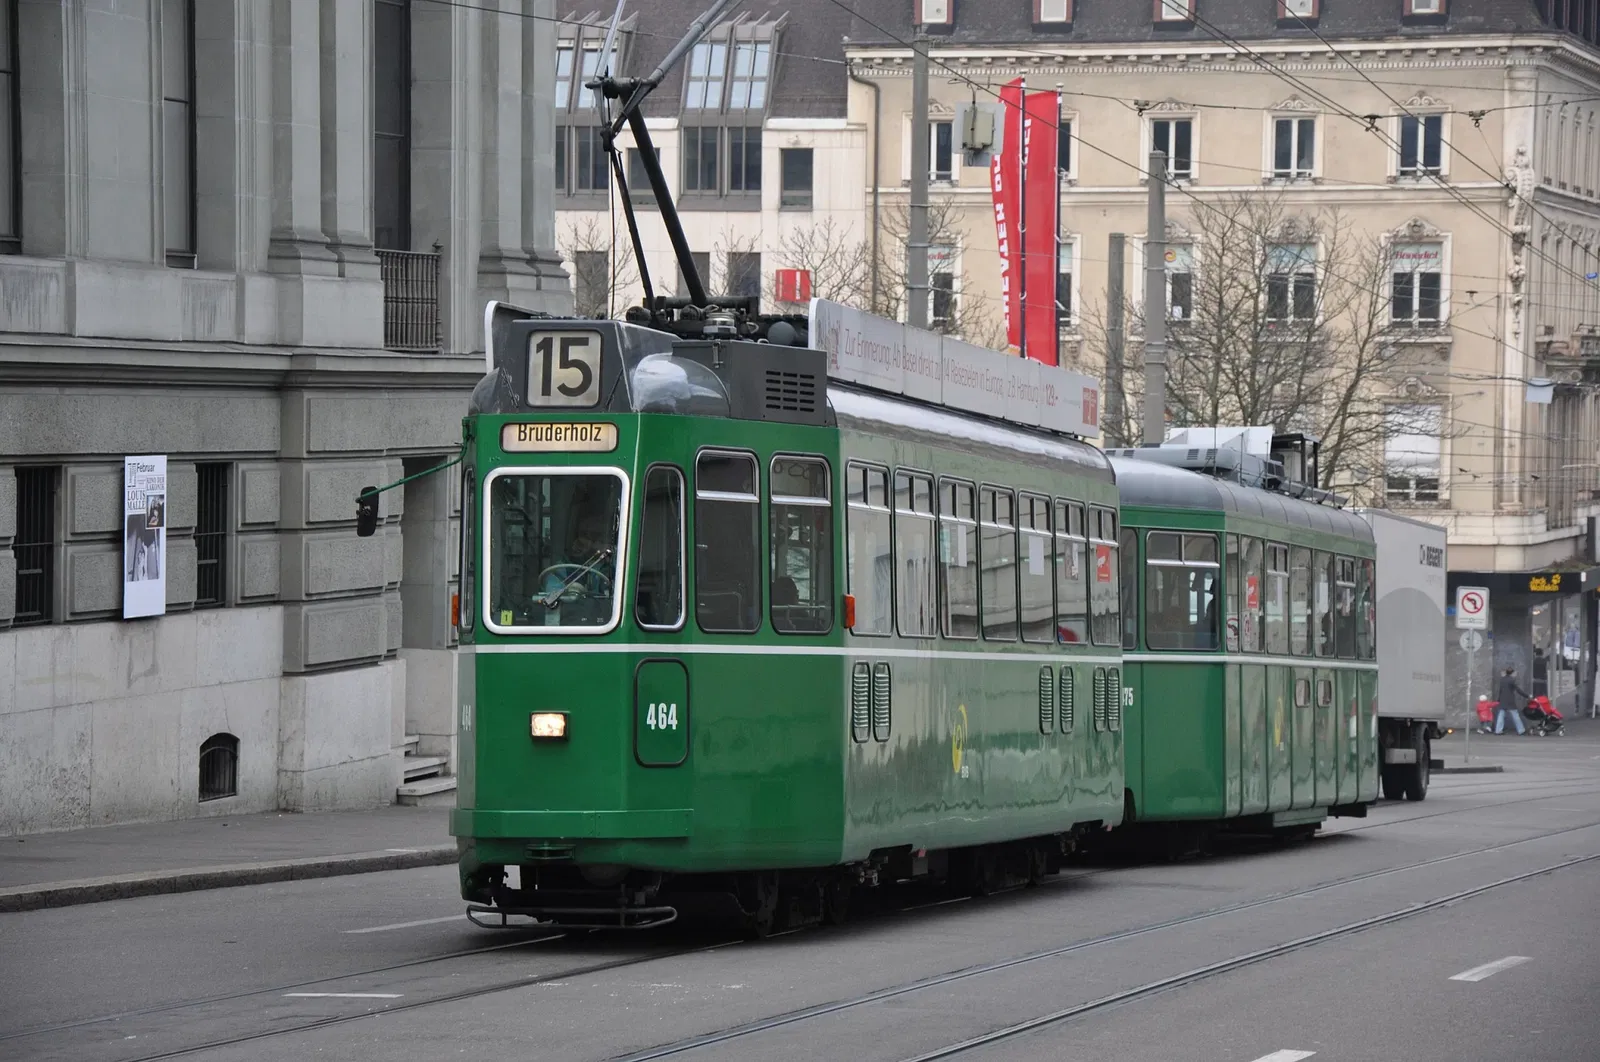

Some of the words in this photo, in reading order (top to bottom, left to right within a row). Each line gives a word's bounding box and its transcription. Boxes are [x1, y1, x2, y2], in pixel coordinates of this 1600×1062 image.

[535, 336, 593, 397] 15
[518, 423, 602, 442] Bruderholz
[137, 463, 155, 472] Februar
[127, 490, 145, 501] LOUIS
[647, 702, 678, 731] 464
